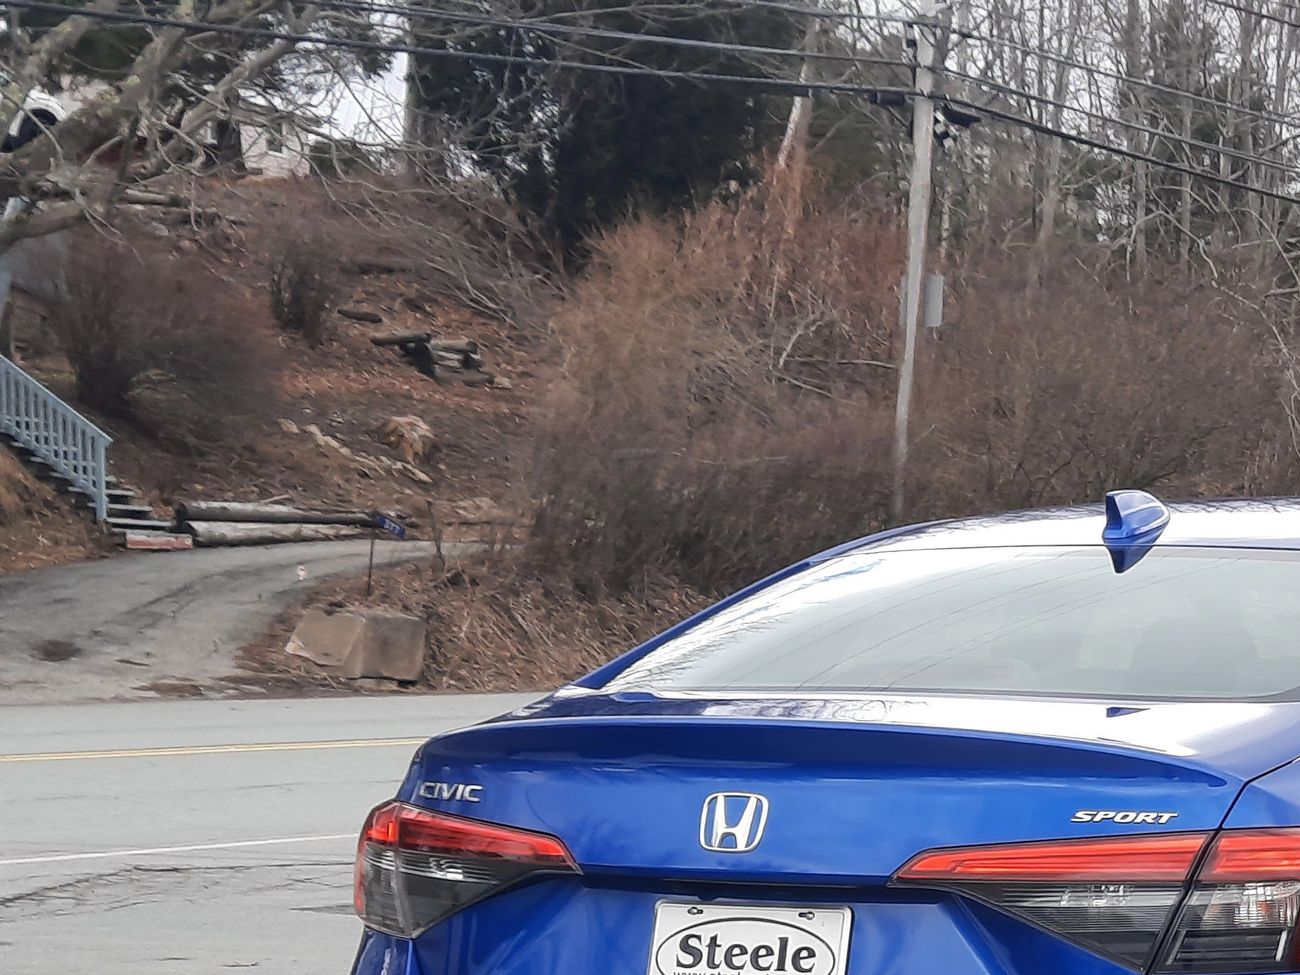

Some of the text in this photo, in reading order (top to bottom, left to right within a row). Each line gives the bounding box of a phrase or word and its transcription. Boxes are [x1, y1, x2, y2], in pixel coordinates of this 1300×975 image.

[420, 782, 483, 802] CIVIC
[1071, 810, 1179, 824] SPORT
[676, 933, 816, 973] Steele
